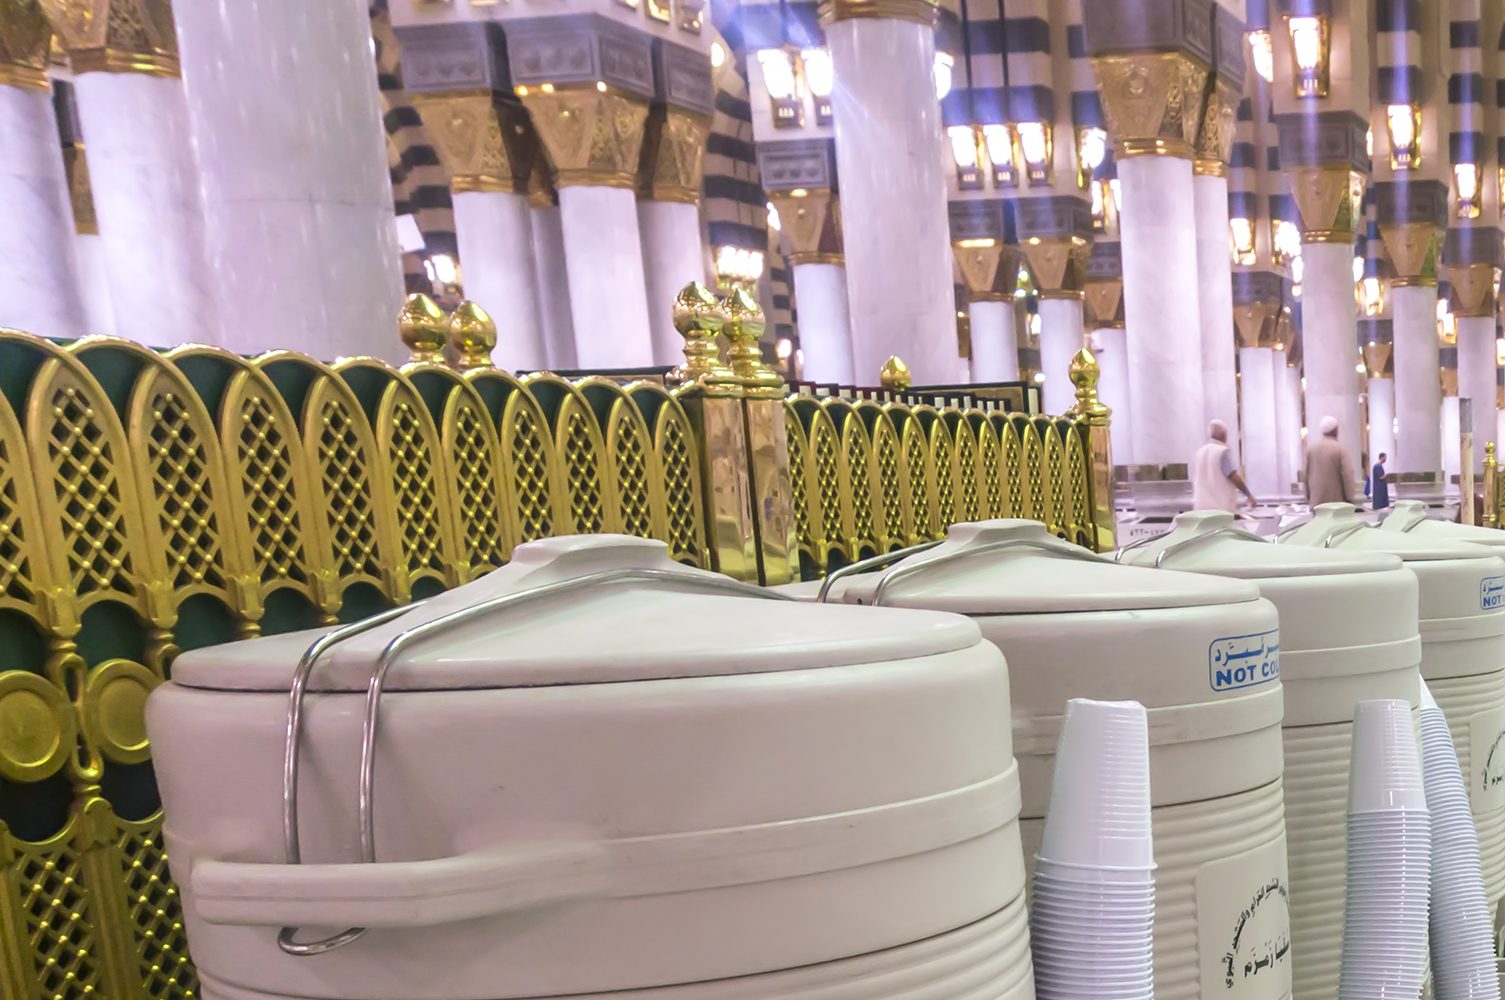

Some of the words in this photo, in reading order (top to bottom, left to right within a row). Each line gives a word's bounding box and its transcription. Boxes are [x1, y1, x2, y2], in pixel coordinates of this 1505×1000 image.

[1483, 595, 1501, 607] NOT
[1216, 665, 1257, 687] NOT
[1262, 658, 1280, 677] COL
